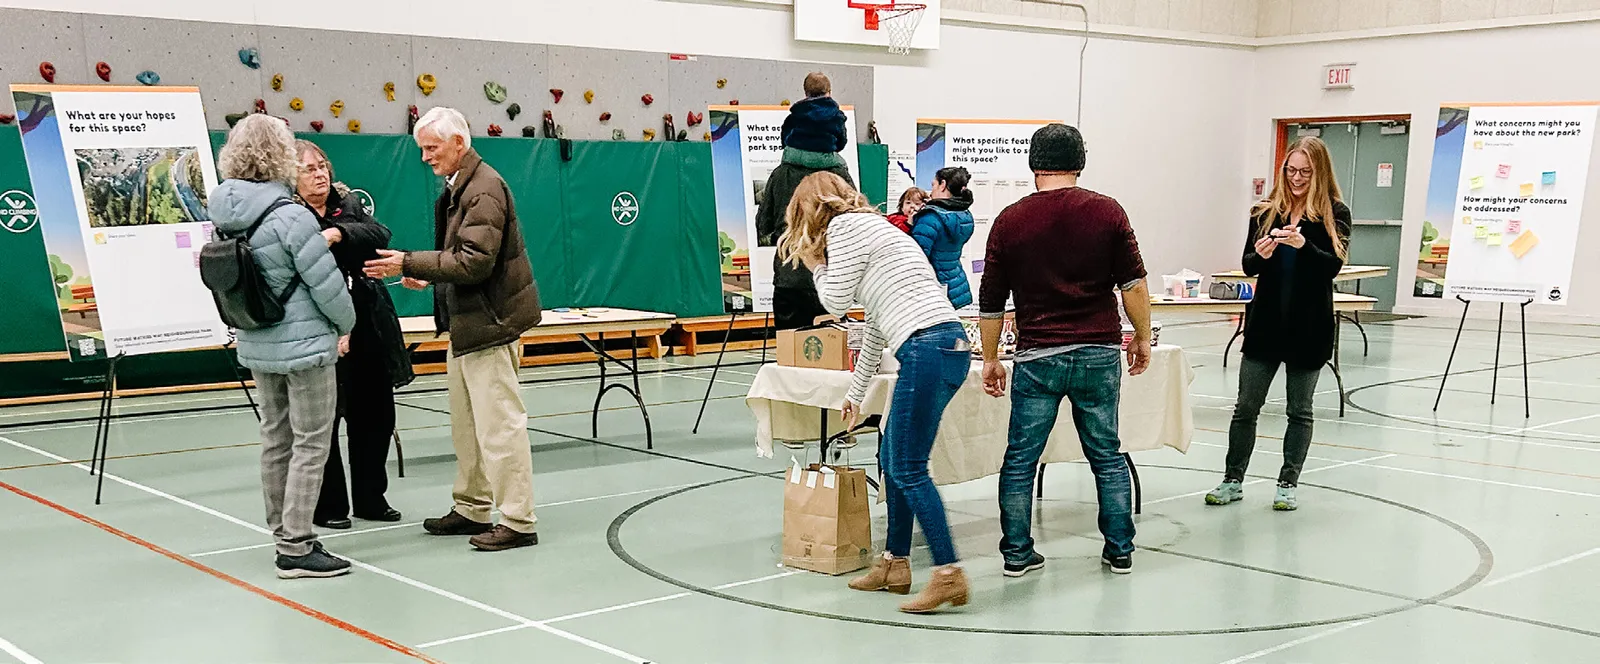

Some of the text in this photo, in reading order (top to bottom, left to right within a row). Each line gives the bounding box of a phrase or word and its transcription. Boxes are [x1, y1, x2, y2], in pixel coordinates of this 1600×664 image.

[1329, 69, 1350, 84] EXIT
[66, 110, 96, 120] What
[119, 112, 142, 122] your
[145, 110, 176, 121] hopes
[69, 123, 146, 134] for this space?
[1538, 120, 1562, 128] might
[1556, 129, 1581, 137] park?
[977, 137, 1009, 146] specific
[748, 144, 767, 152] park
[952, 146, 976, 155] might
[970, 155, 998, 164] space?
[1483, 196, 1506, 204] might
